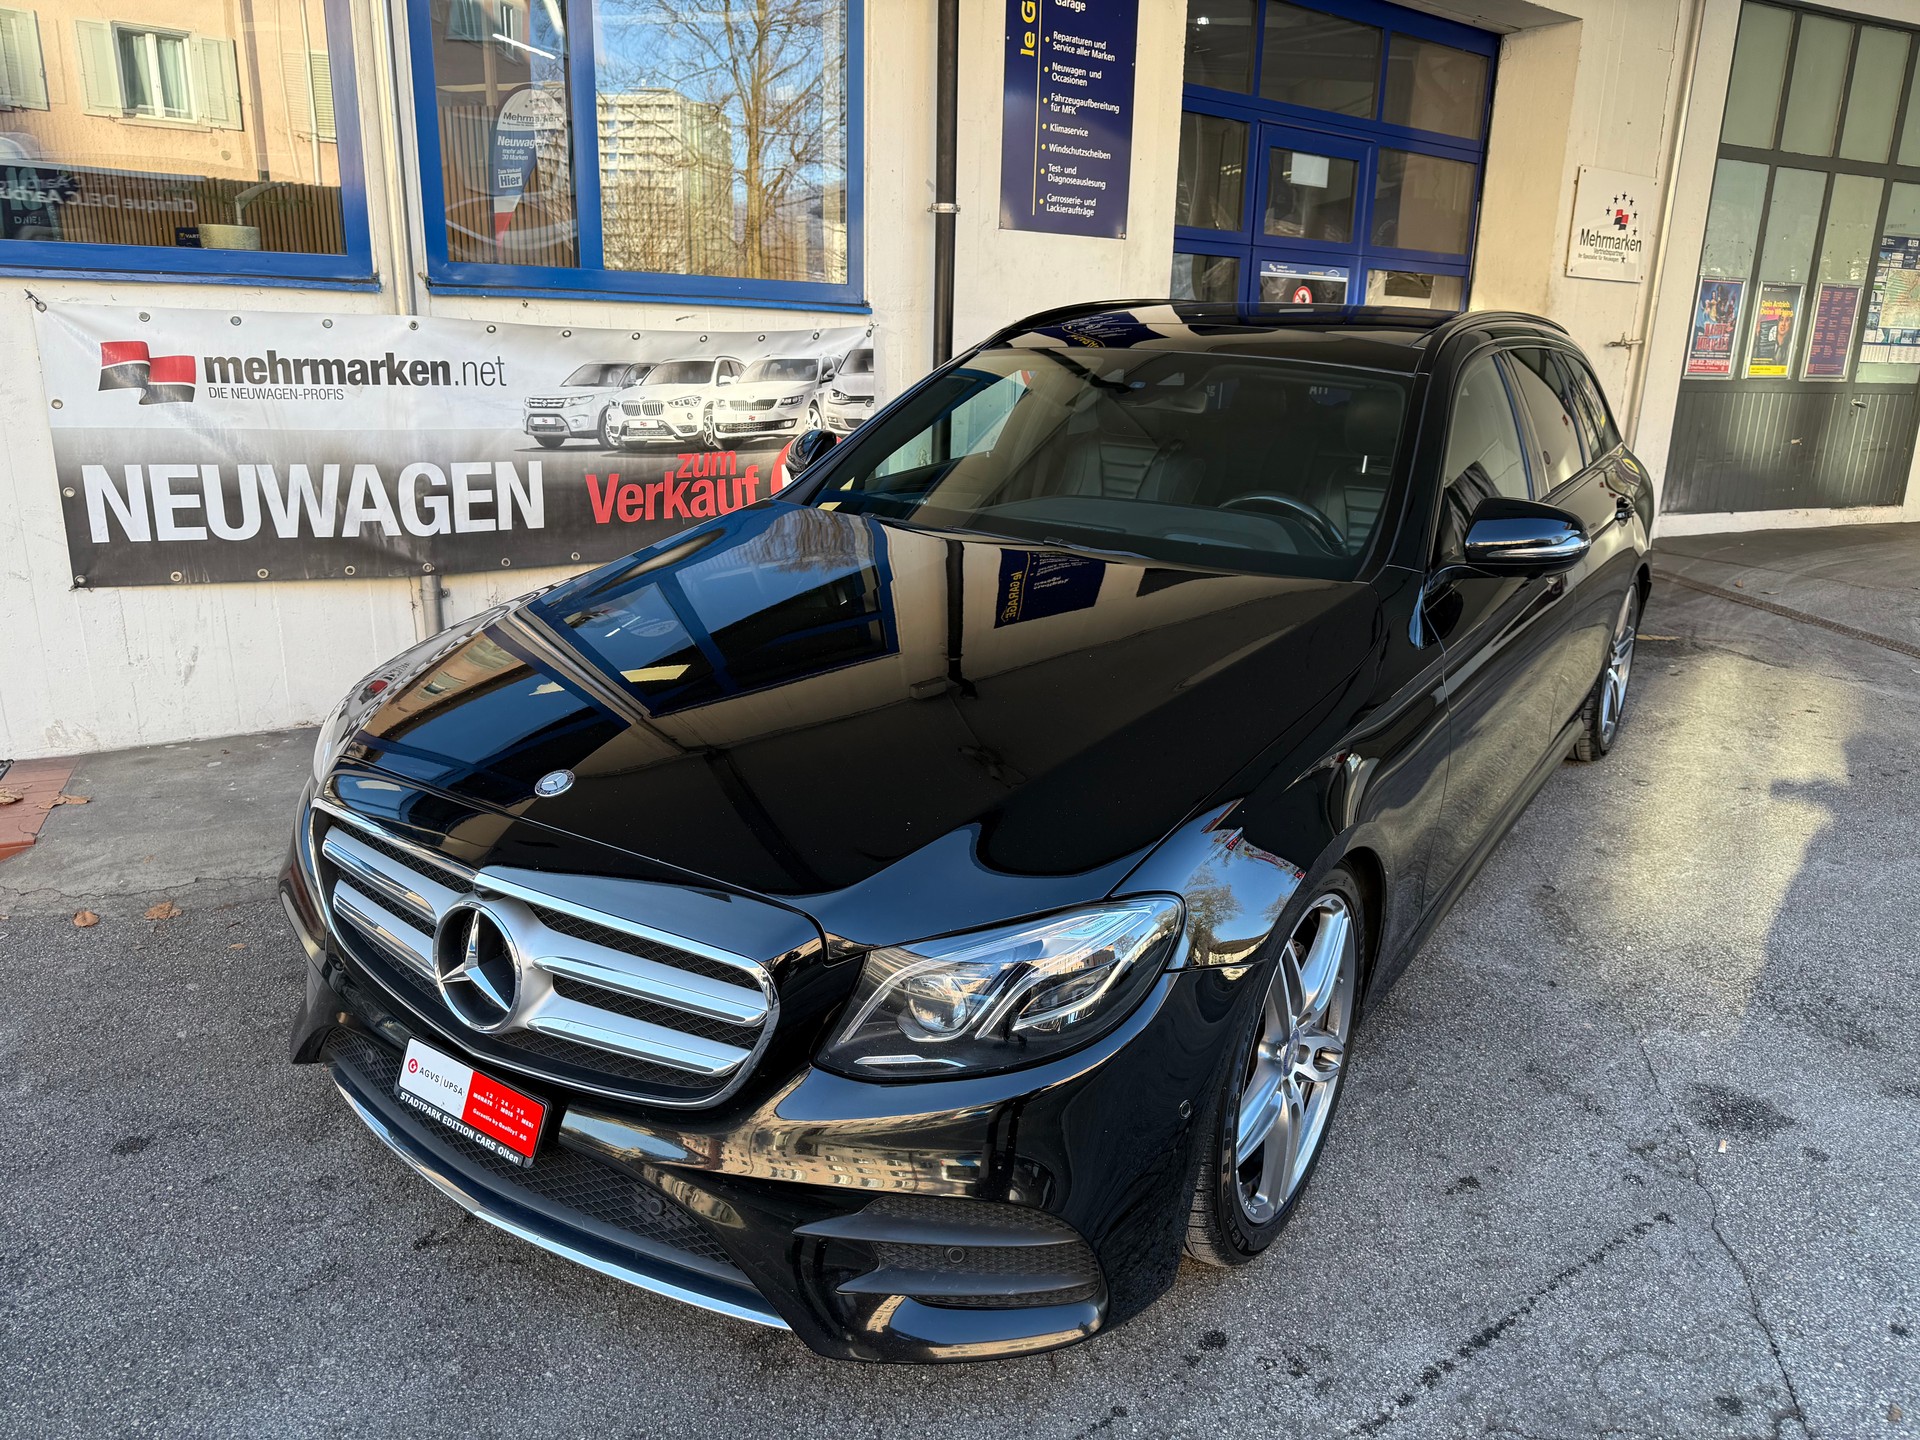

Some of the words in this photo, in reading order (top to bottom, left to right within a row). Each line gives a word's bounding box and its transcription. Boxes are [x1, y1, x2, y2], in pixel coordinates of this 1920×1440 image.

[1020, 31, 1035, 57] le
[1053, 31, 1092, 47] Reparaturen
[1094, 41, 1106, 50] und
[1052, 42, 1075, 54] Service
[1076, 47, 1090, 56] aller
[1092, 50, 1116, 62] Marken
[1052, 62, 1086, 77] Neuwagen
[1089, 71, 1102, 79] und
[1052, 72, 1088, 86] Occasionen
[1050, 103, 1060, 112] für
[1062, 104, 1076, 115] MFK
[1051, 92, 1120, 114] Fahrzeugaufbereitung
[1050, 123, 1088, 137] Klimaservice
[1049, 143, 1111, 160] Windschutzscheiben
[1048, 164, 1063, 173] Test-
[1064, 166, 1077, 174] und
[500, 176, 520, 187] Hier
[1048, 174, 1106, 190] Diagnoseauslesung
[1047, 194, 1083, 205] Carrosserie-
[1084, 198, 1096, 206] und
[1046, 204, 1094, 218] Lackieraufträge
[1580, 228, 1642, 252] Mehrmarken
[204, 350, 506, 387] mehrmarken.net
[209, 387, 228, 400] DIE
[231, 387, 344, 400] NEUWAGEN-PROFIS
[676, 450, 736, 479] zum
[585, 464, 759, 524] Verkauf
[81, 462, 544, 544] NEUWAGEN
[400, 1092, 442, 1122] STADTPARK
[442, 1116, 474, 1139] EDITION
[476, 1134, 496, 1151] CARS
[498, 1146, 519, 1164] Olten
